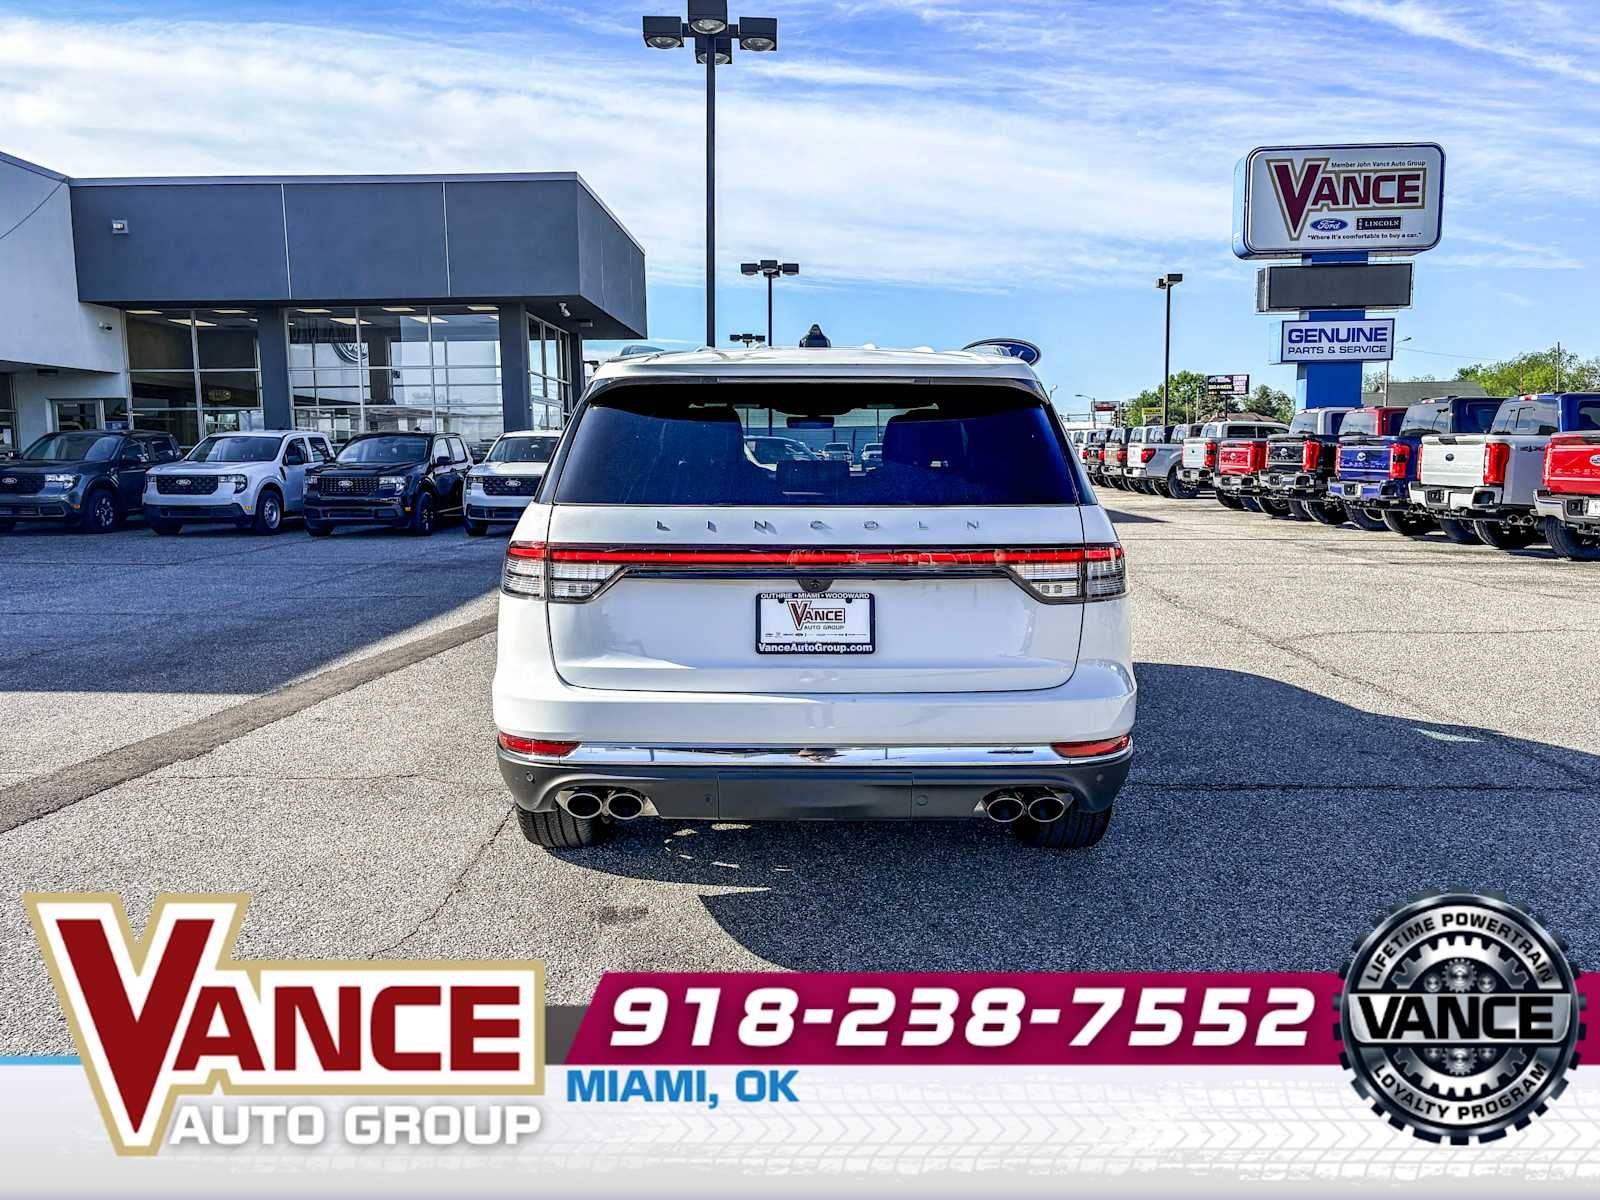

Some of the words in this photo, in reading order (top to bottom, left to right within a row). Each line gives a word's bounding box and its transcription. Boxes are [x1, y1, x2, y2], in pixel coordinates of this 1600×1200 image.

[1407, 160, 1426, 168] Group
[1271, 162, 1422, 236] VANCE
[1316, 219, 1341, 231] Ford
[1364, 220, 1400, 228] LINCOLN
[1389, 233, 1401, 241] buy
[1287, 327, 1388, 344] GENUINE
[1287, 346, 1324, 355] PARTS
[1327, 346, 1336, 354] &
[1338, 346, 1387, 354] SERVICE
[655, 519, 981, 532] LINCOLN
[789, 602, 844, 627] VANCE
[759, 643, 873, 653] VanceAutoGroup.com
